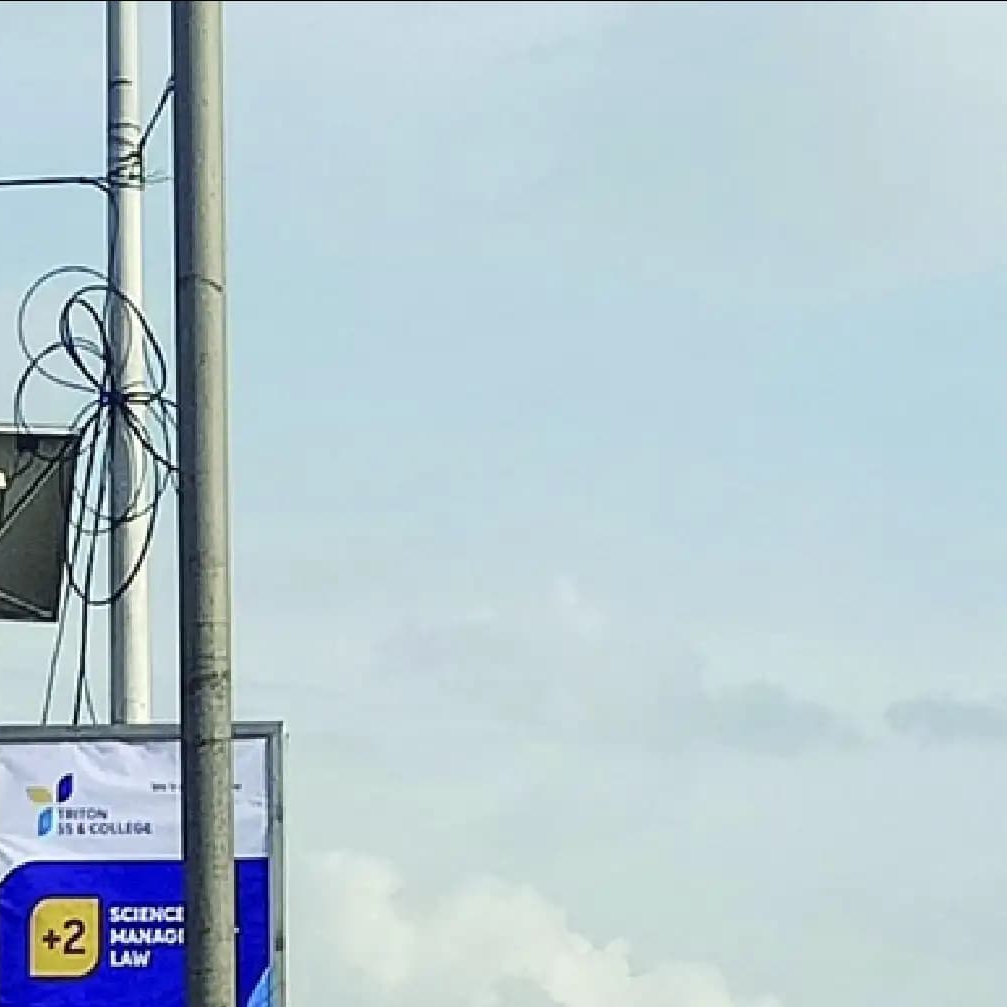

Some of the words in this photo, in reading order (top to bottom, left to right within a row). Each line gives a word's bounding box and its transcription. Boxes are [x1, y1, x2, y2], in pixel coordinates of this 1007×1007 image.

[58, 807, 107, 819] TRITON
[89, 822, 152, 835] COLLEGE
[41, 918, 87, 955] +2
[109, 950, 151, 968] LAW
